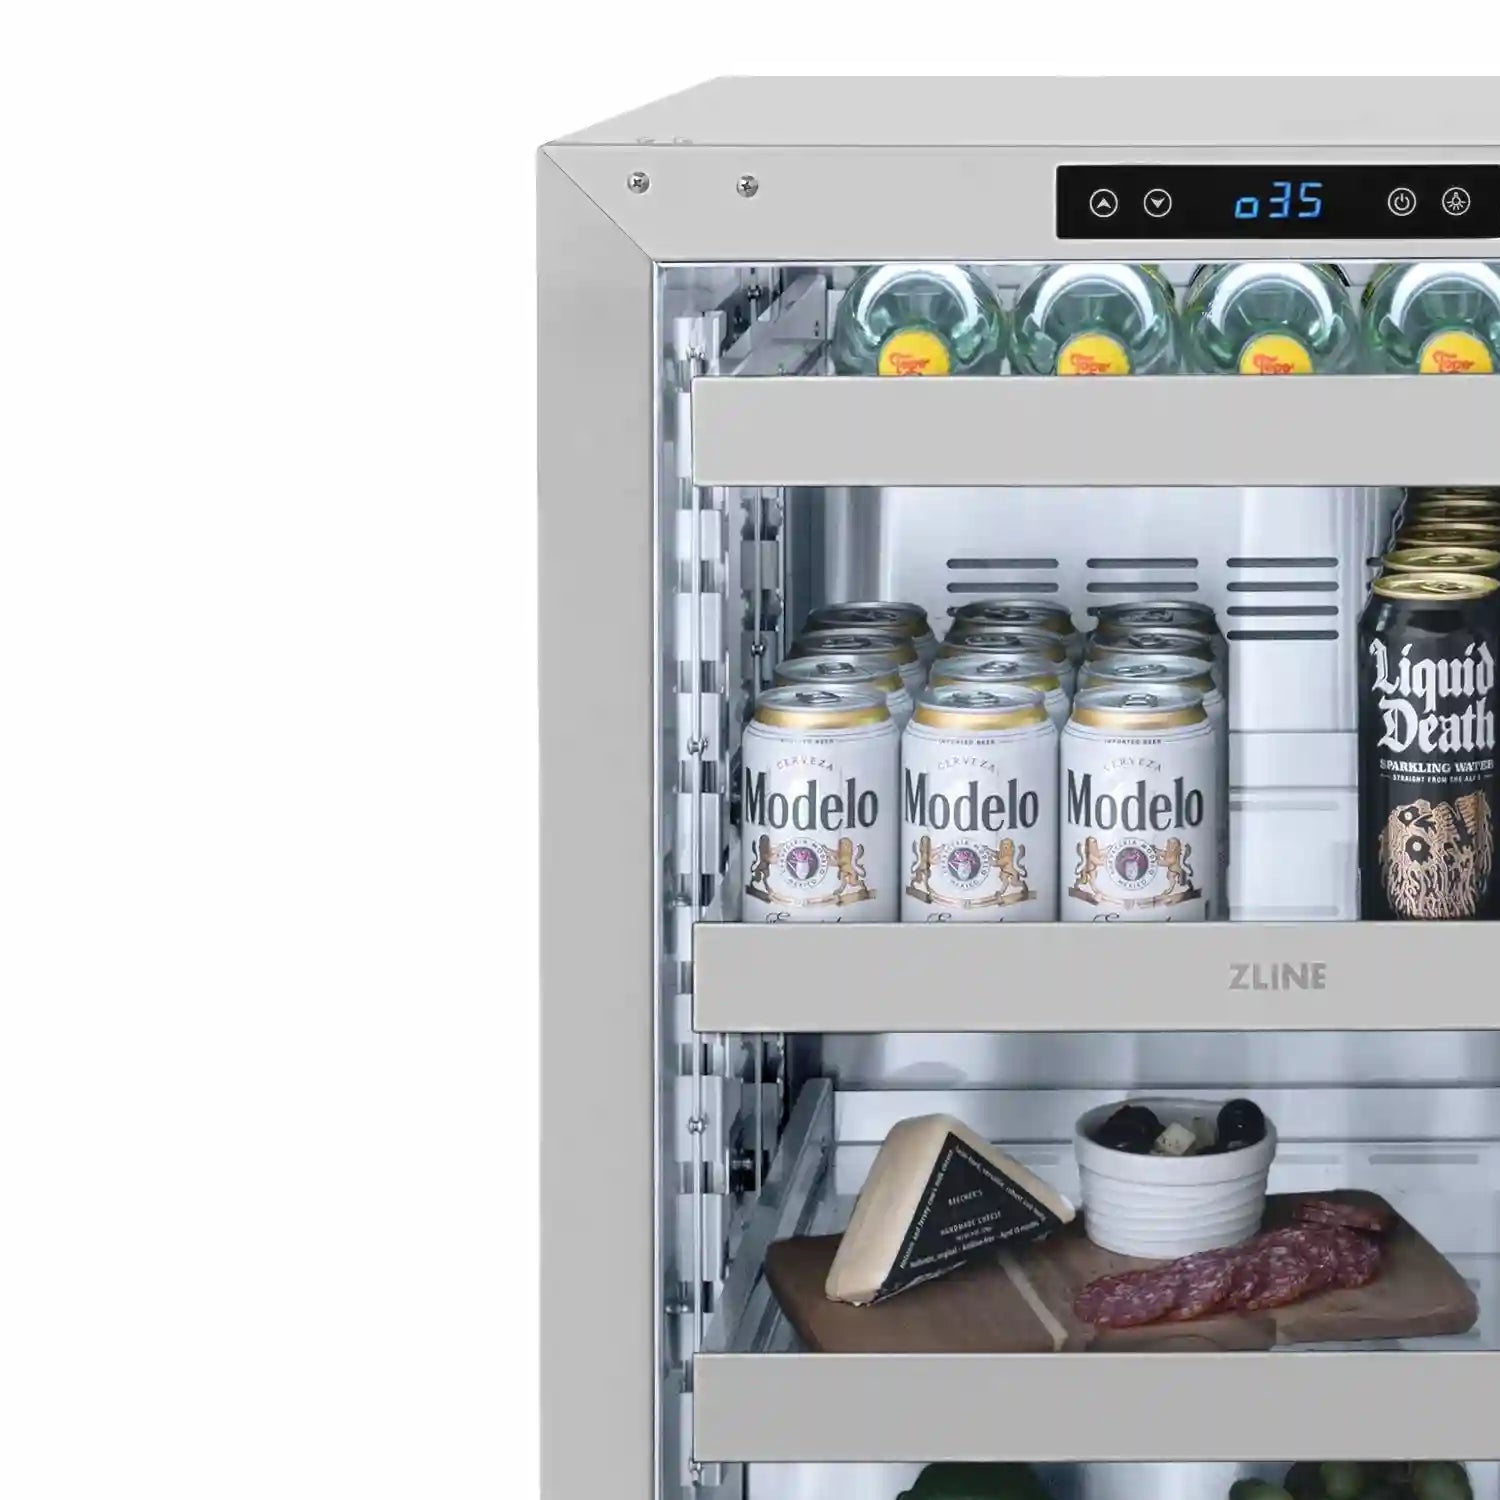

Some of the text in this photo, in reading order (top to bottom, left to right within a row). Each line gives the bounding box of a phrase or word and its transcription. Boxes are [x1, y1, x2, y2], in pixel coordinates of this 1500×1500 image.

[1369, 638, 1495, 714] Liquid
[1377, 695, 1496, 753] Death
[1379, 758, 1495, 773] SPARKLING WATER
[1392, 774, 1425, 783] STRAIGHT
[1427, 775, 1447, 784] FROM
[745, 767, 879, 831] Modelo
[905, 767, 1039, 831] Modelo
[1067, 769, 1205, 831] Modelo
[1229, 961, 1327, 991] ZLINE
